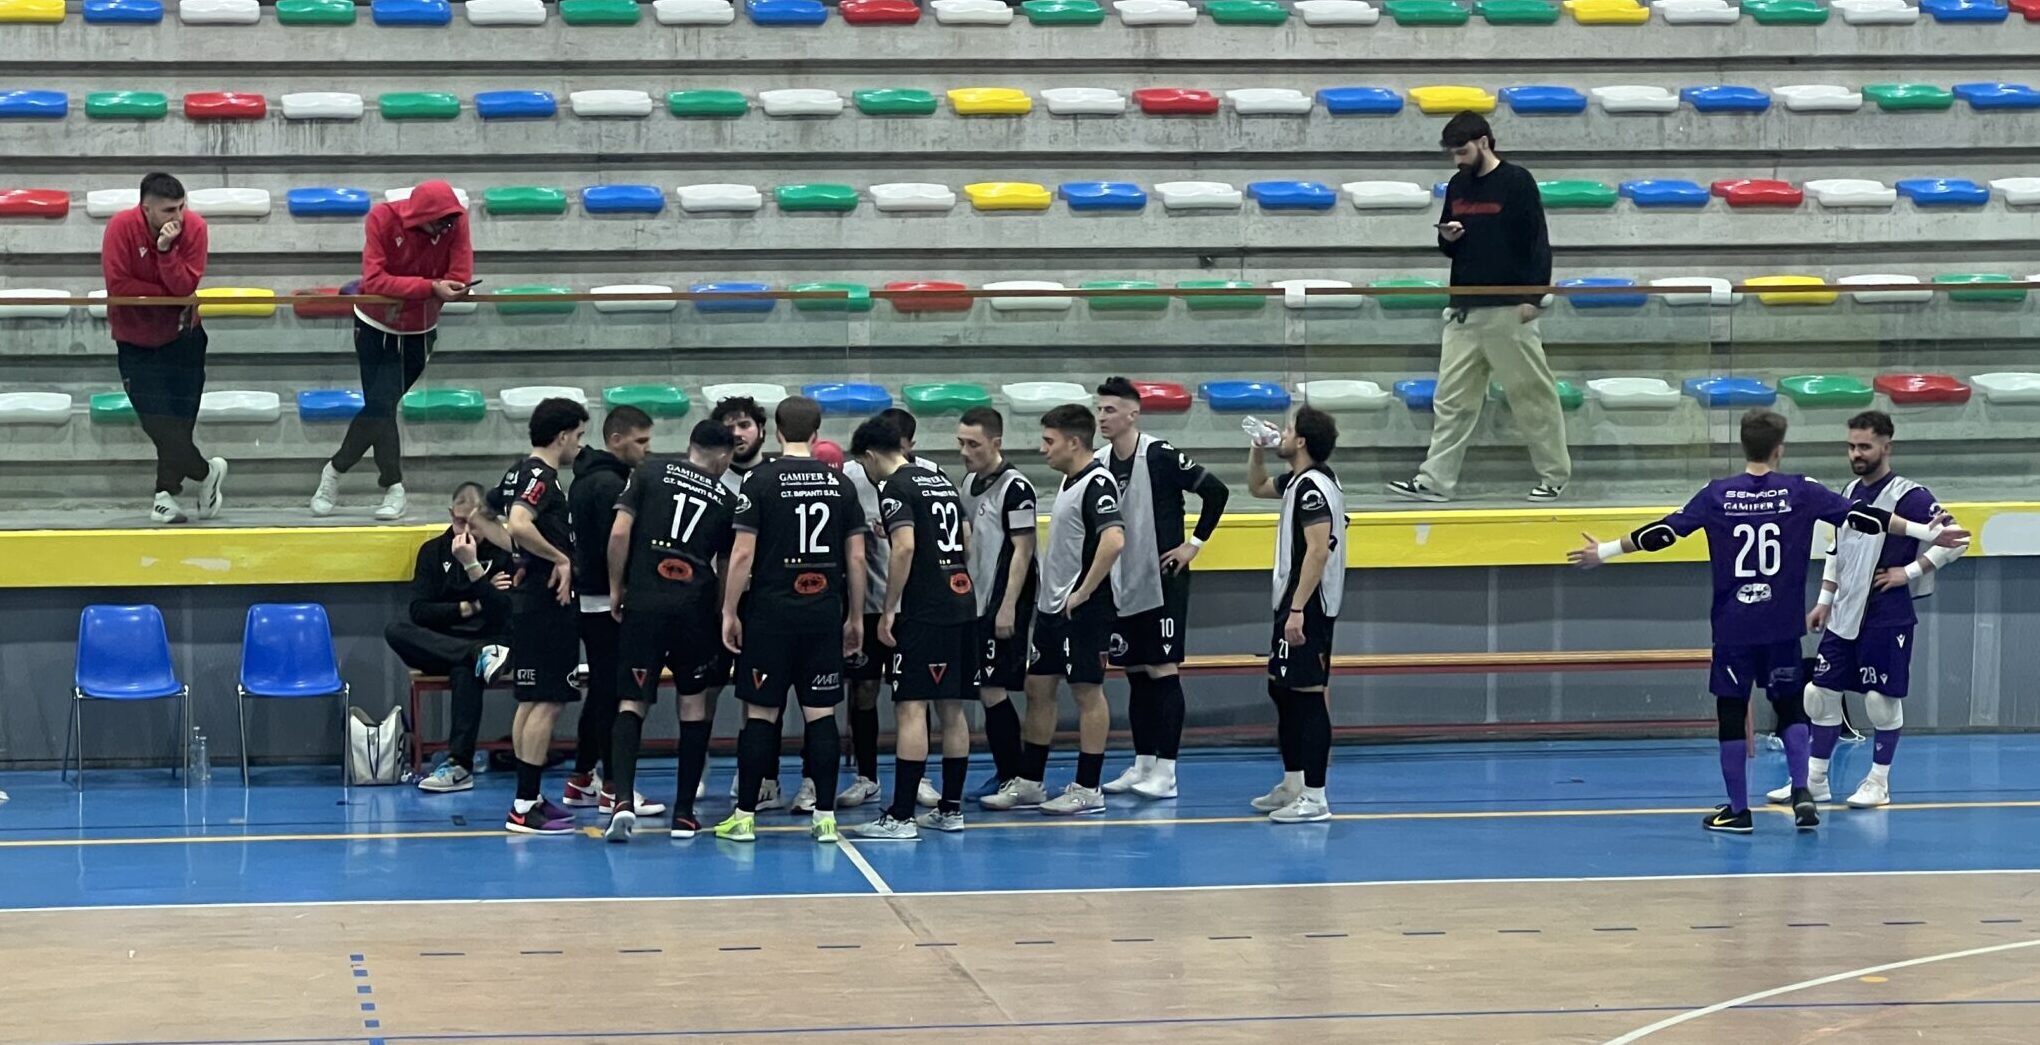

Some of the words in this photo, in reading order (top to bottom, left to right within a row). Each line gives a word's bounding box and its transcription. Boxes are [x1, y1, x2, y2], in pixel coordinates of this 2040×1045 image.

[666, 464, 712, 485] GAMIFER
[779, 472, 825, 481] GAMIFER
[1723, 502, 1774, 511] GAMIFER
[670, 492, 708, 543] 17
[795, 502, 830, 553] 12
[932, 502, 963, 552] 32
[1733, 523, 1781, 577] 26
[1160, 618, 1174, 638] 10
[986, 639, 996, 659] 3
[1860, 667, 1877, 685] 28
